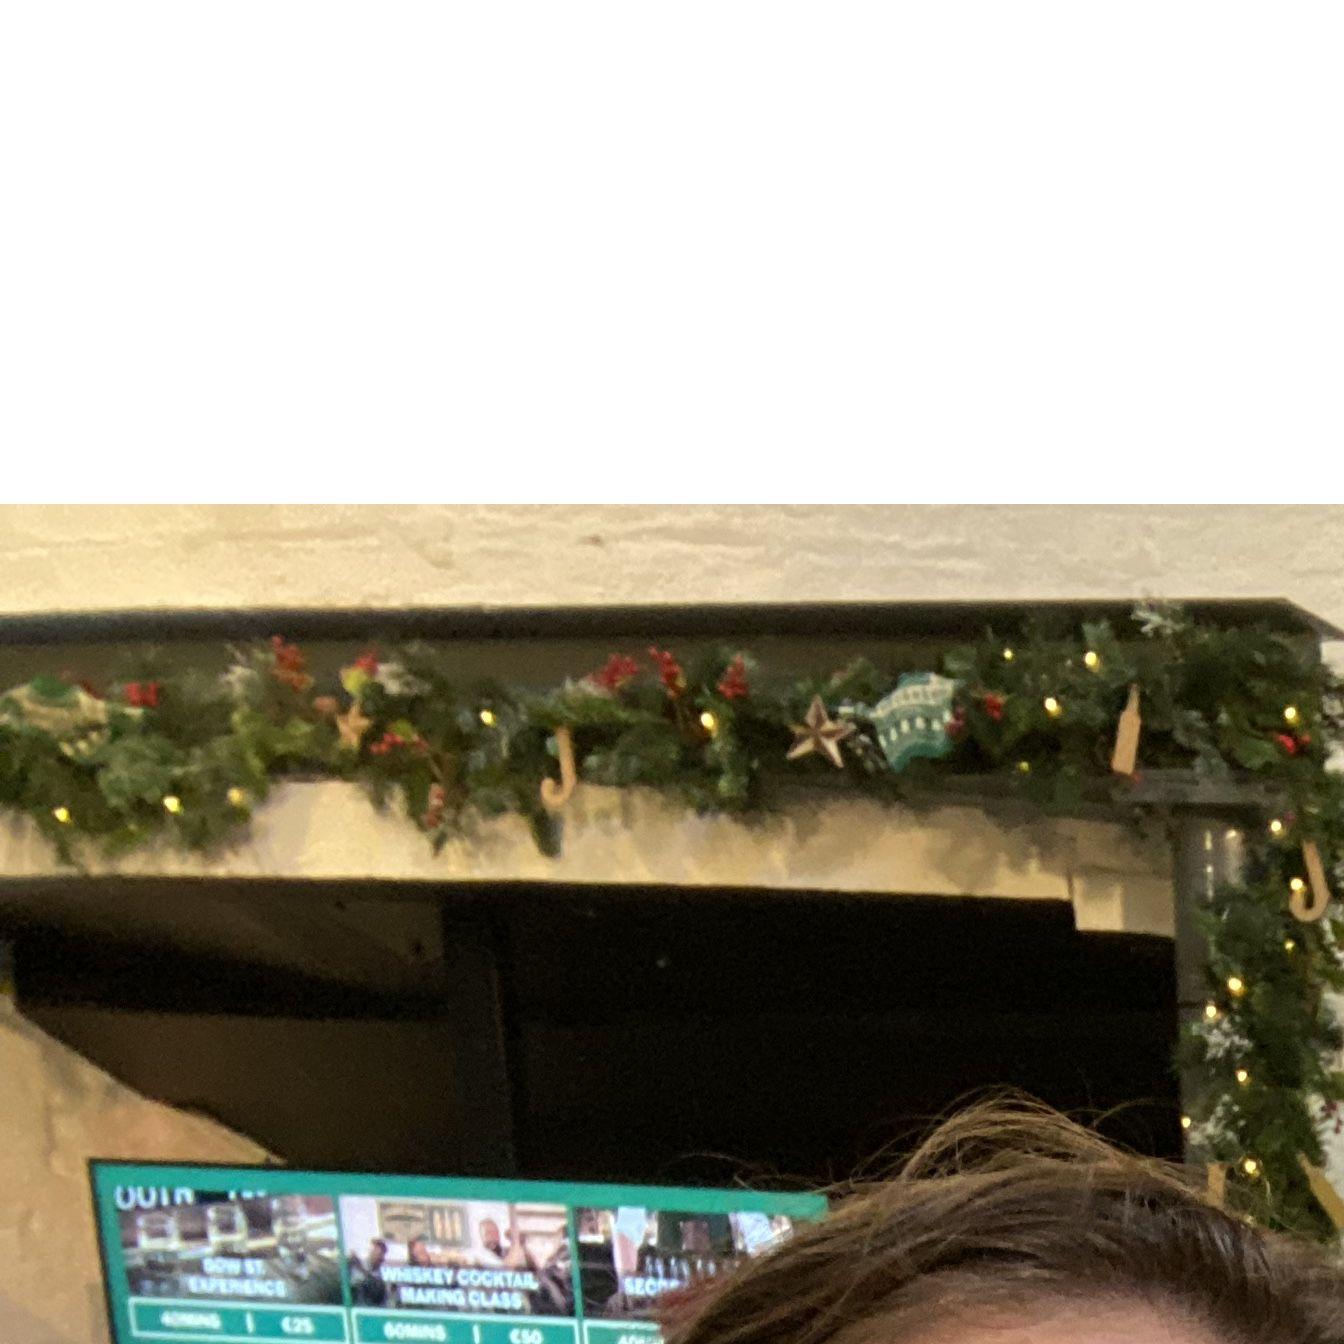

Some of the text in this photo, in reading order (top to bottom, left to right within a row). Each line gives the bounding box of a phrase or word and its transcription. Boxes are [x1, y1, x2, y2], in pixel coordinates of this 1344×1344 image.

[186, 1276, 287, 1297] EXPERIENCE
[380, 1266, 539, 1290] WHISKEY COCKTAIL
[400, 1286, 523, 1310] MAKING CLASS
